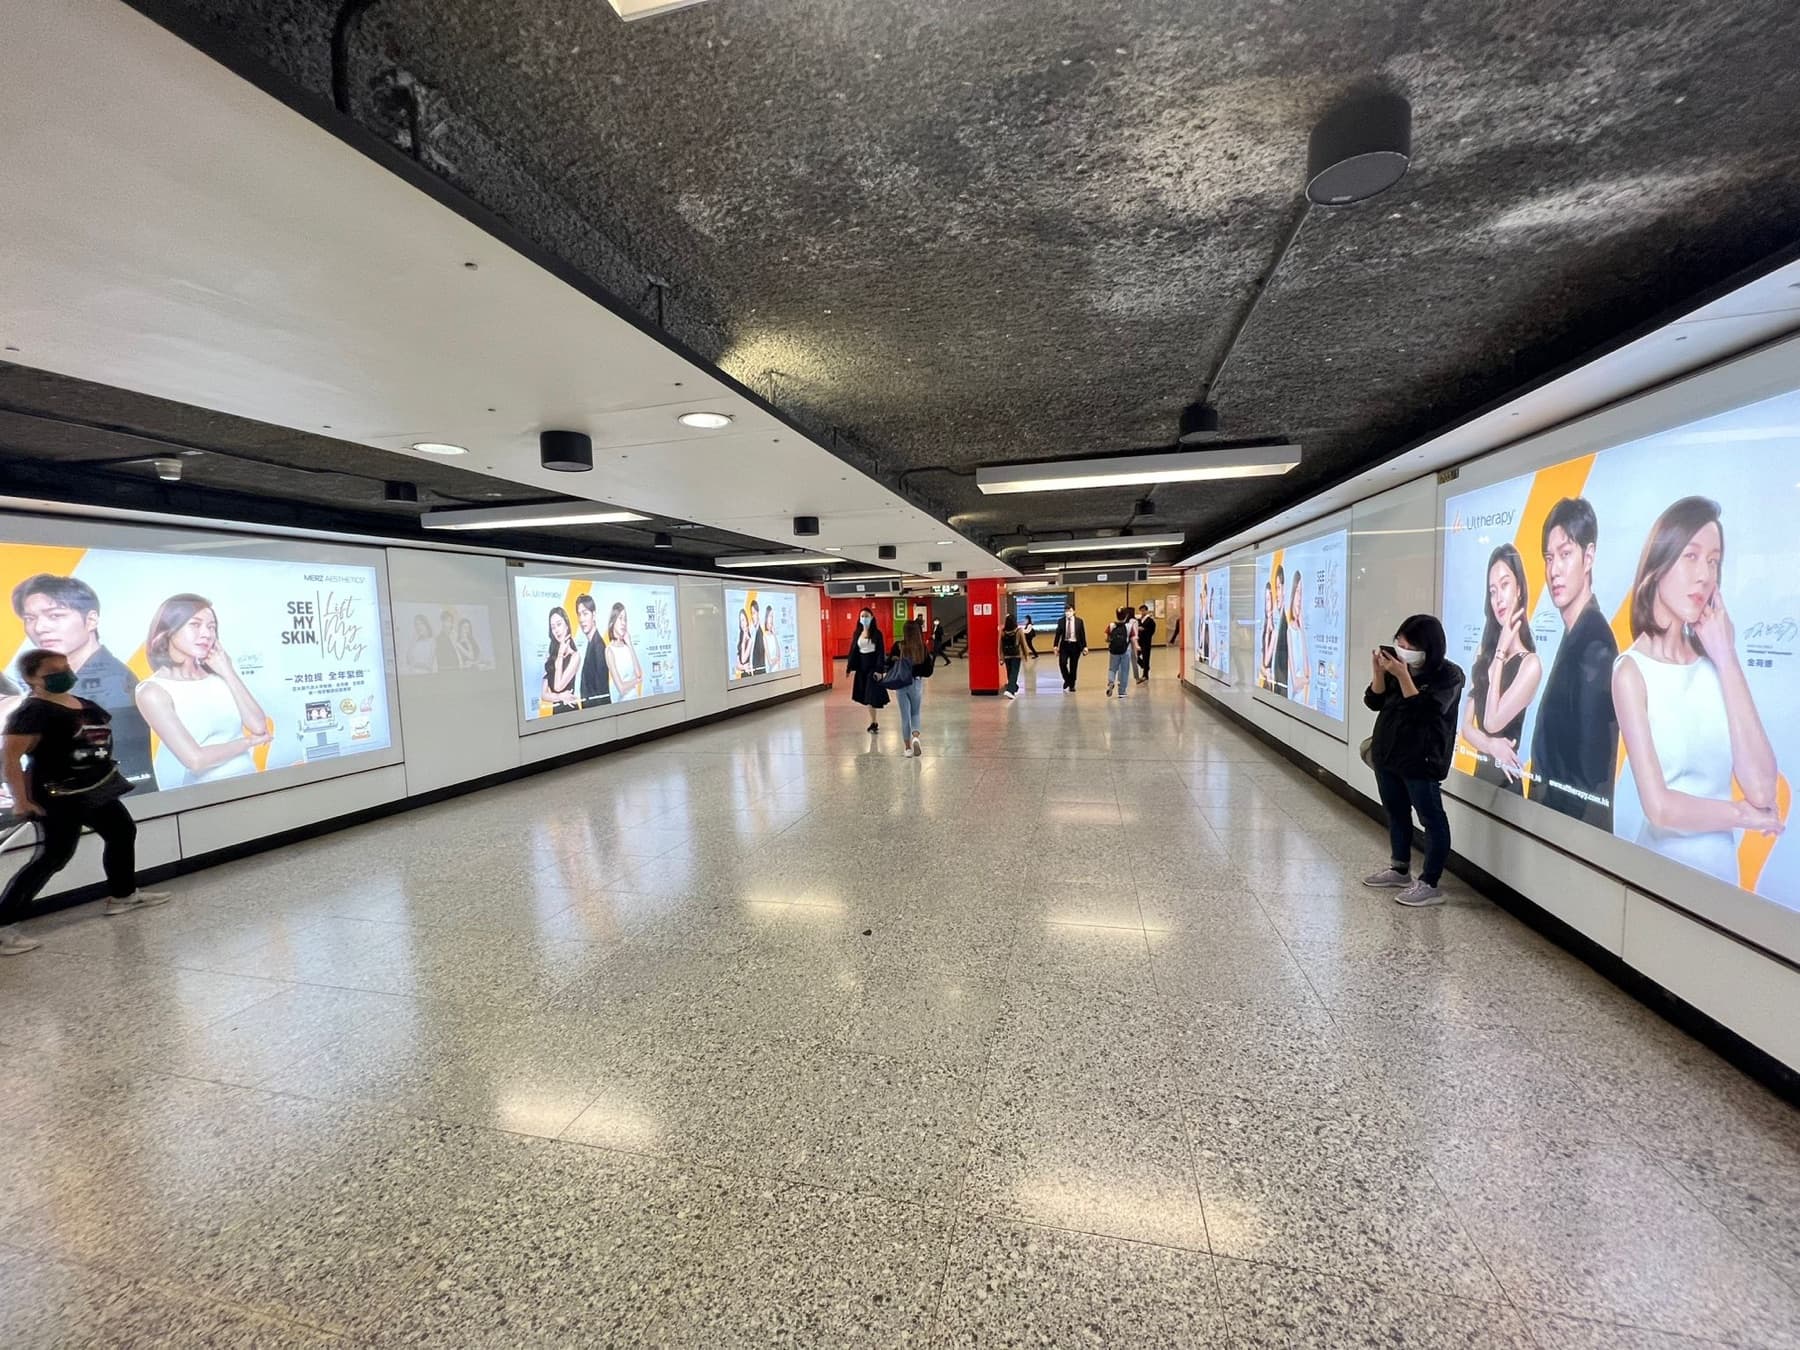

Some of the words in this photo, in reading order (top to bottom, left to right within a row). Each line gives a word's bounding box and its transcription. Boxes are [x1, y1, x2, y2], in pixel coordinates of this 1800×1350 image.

[1467, 510, 1514, 530] Ultherapy
[287, 601, 314, 615] SEE
[323, 591, 361, 620] Lift
[897, 602, 905, 616] E
[293, 615, 314, 630] MY
